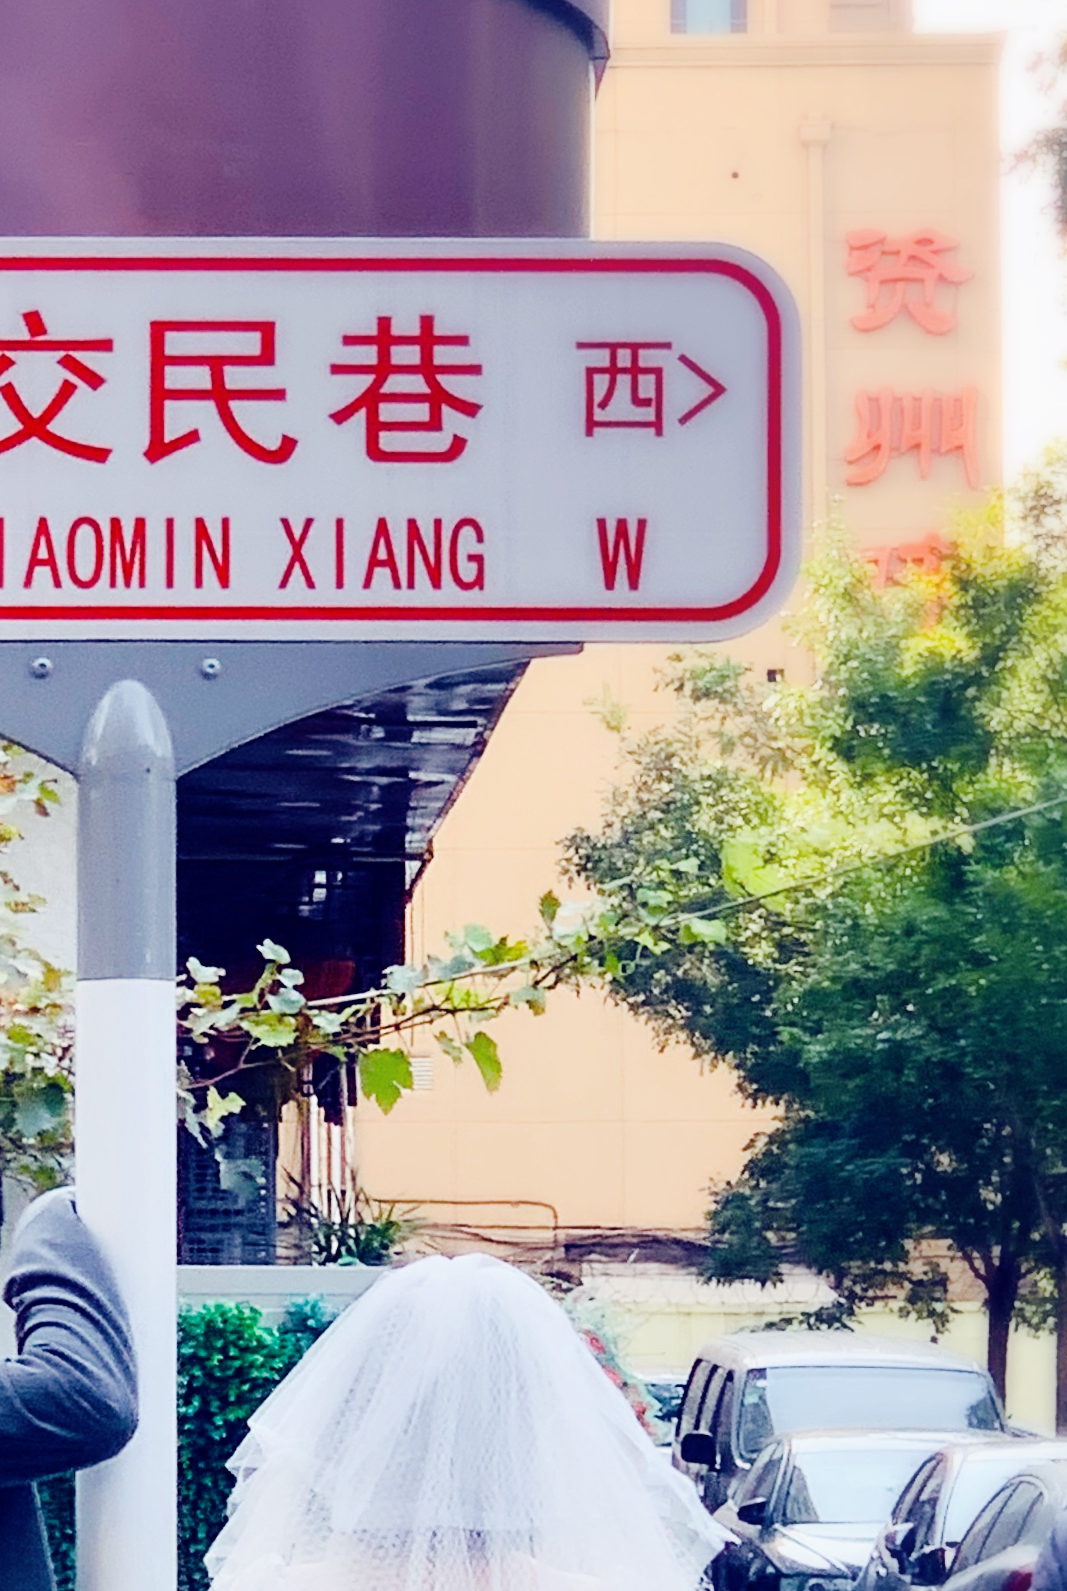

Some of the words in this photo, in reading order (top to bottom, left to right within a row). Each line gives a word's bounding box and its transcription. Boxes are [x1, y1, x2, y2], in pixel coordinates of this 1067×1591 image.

[575, 340, 673, 438] 西
[844, 227, 980, 628] 资州
[277, 516, 486, 591] XIANG
[595, 516, 648, 592] W
